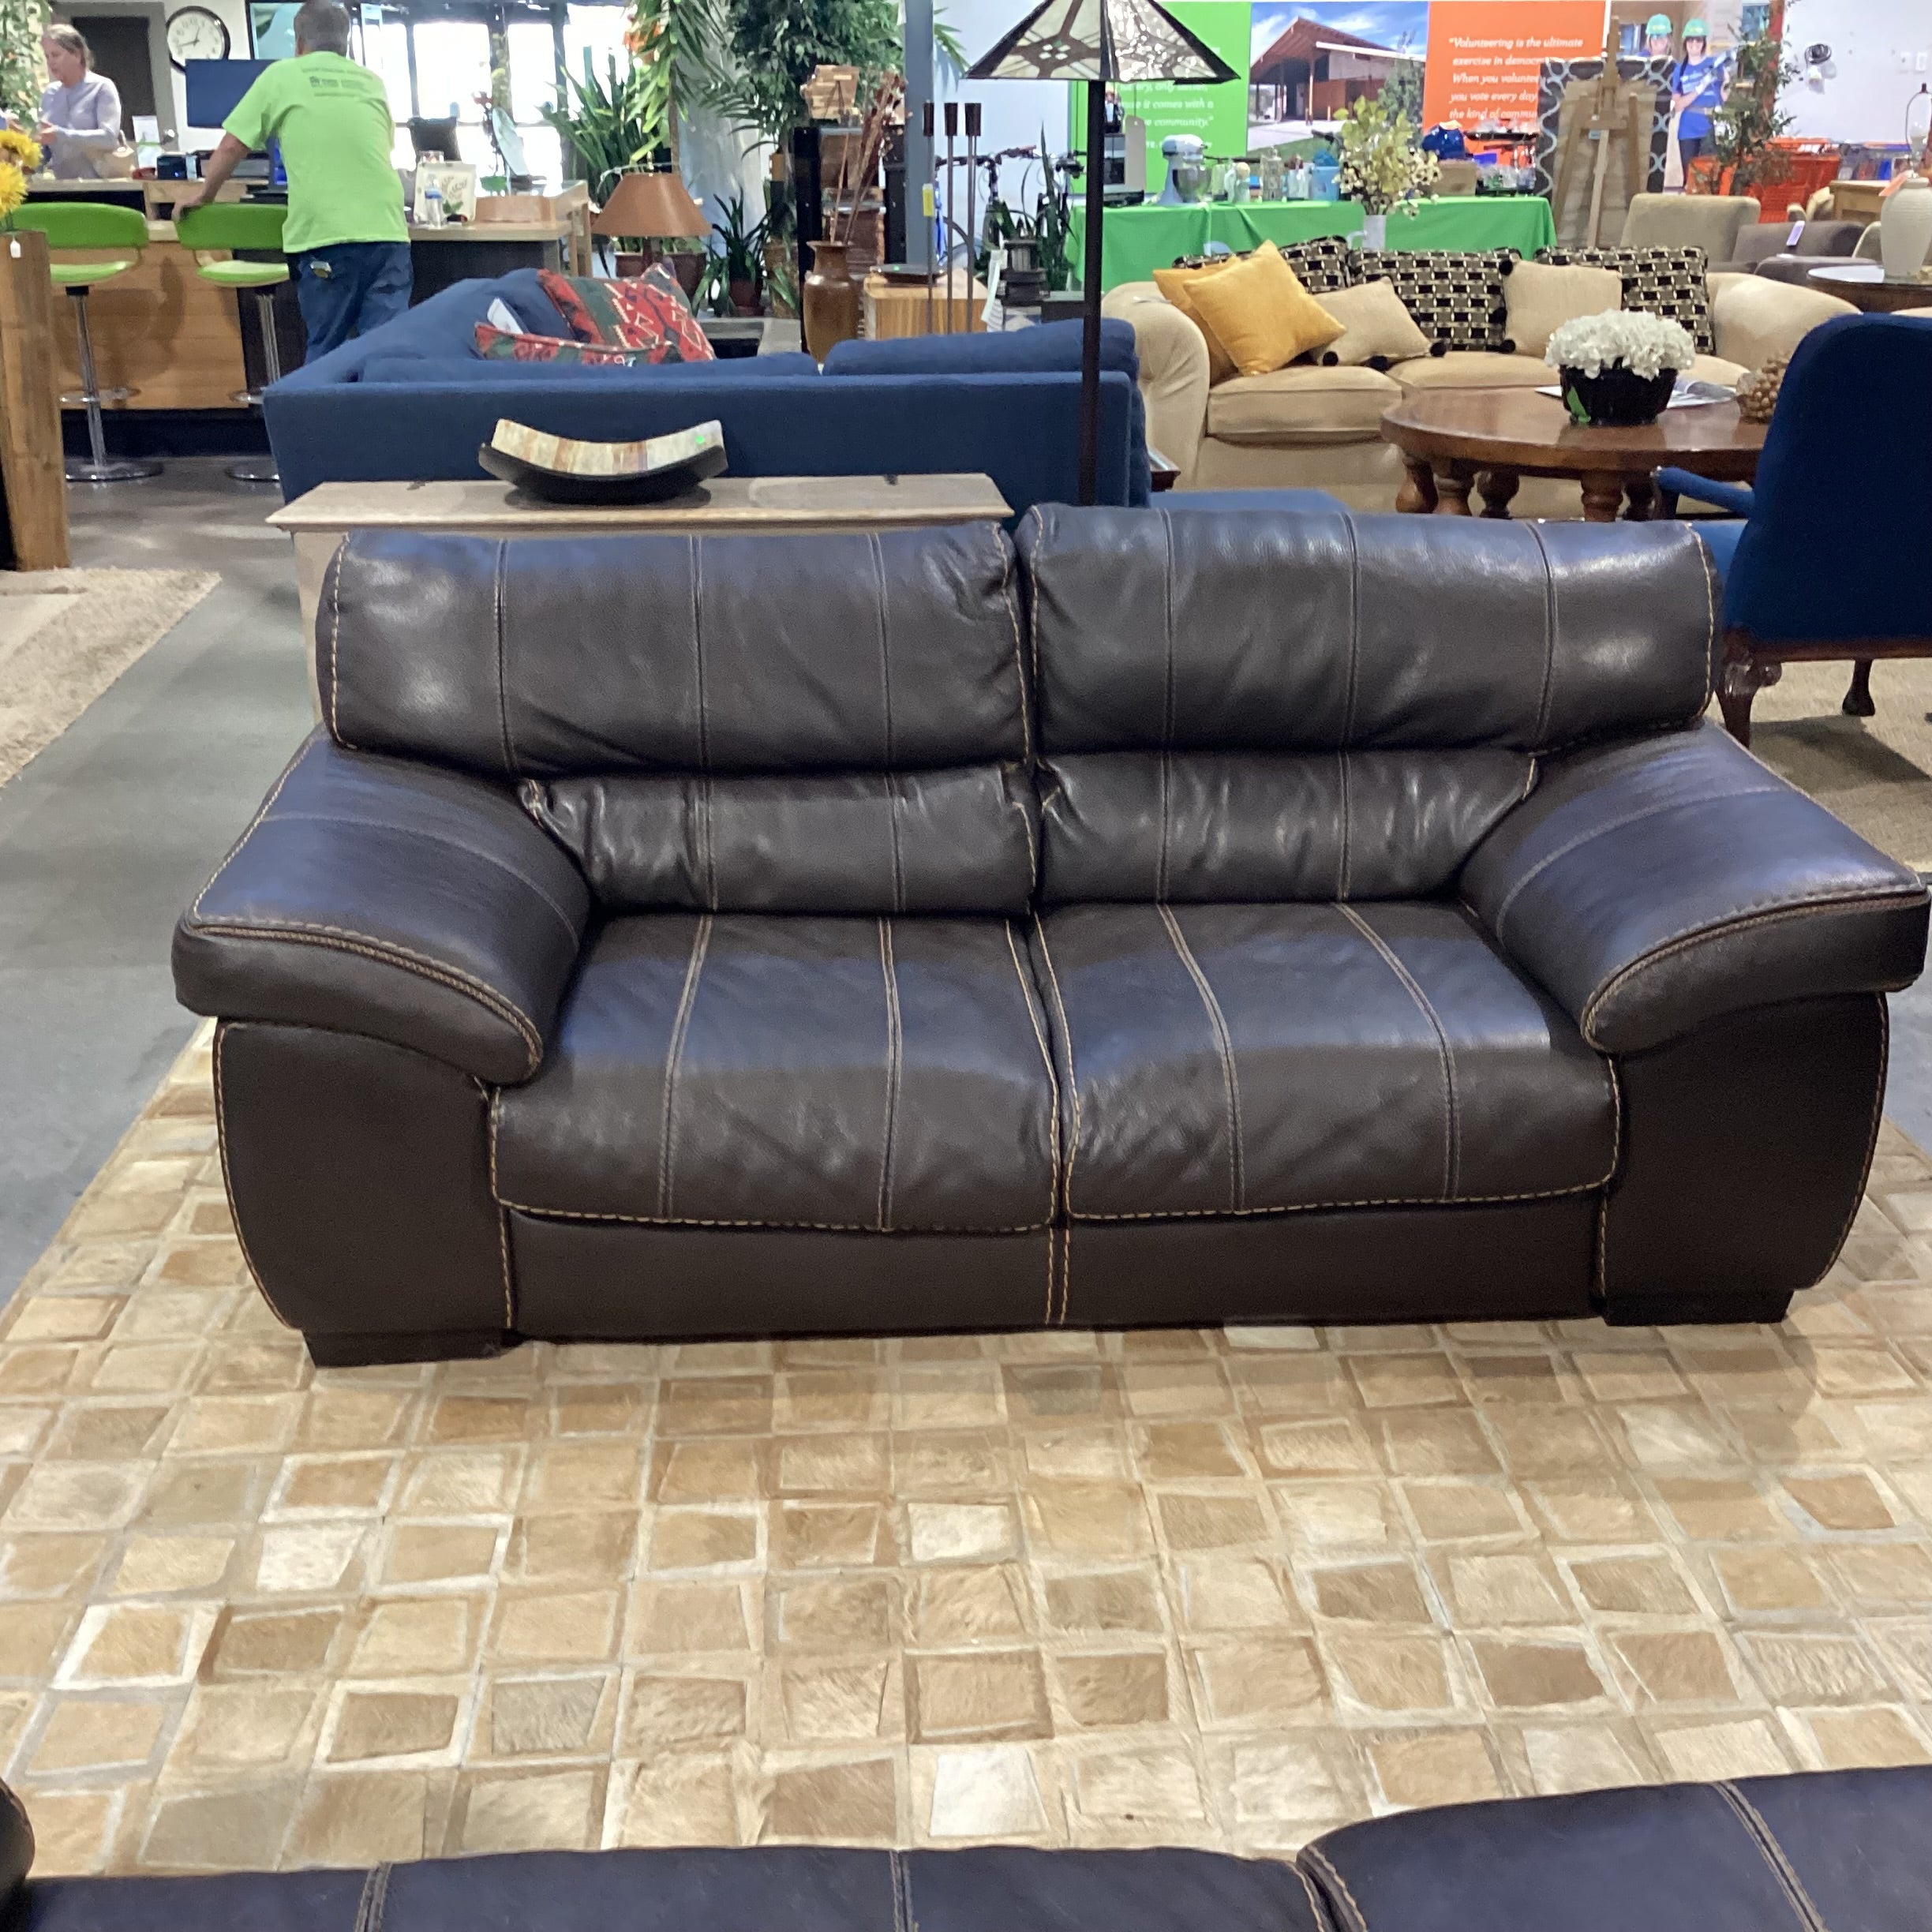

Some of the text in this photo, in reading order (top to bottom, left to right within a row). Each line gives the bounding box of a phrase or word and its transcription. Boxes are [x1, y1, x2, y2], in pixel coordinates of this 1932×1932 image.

[1515, 38, 1524, 47] is
[1526, 36, 1541, 47] the
[1543, 36, 1583, 47] ultimate
[1452, 57, 1492, 66] exercise
[1493, 56, 1503, 66] in
[1452, 73, 1539, 85] When you voluntee
[1449, 92, 1467, 104] you
[1470, 92, 1489, 101] vote
[1491, 92, 1517, 103] every
[1449, 107, 1537, 120] the kind of commu
